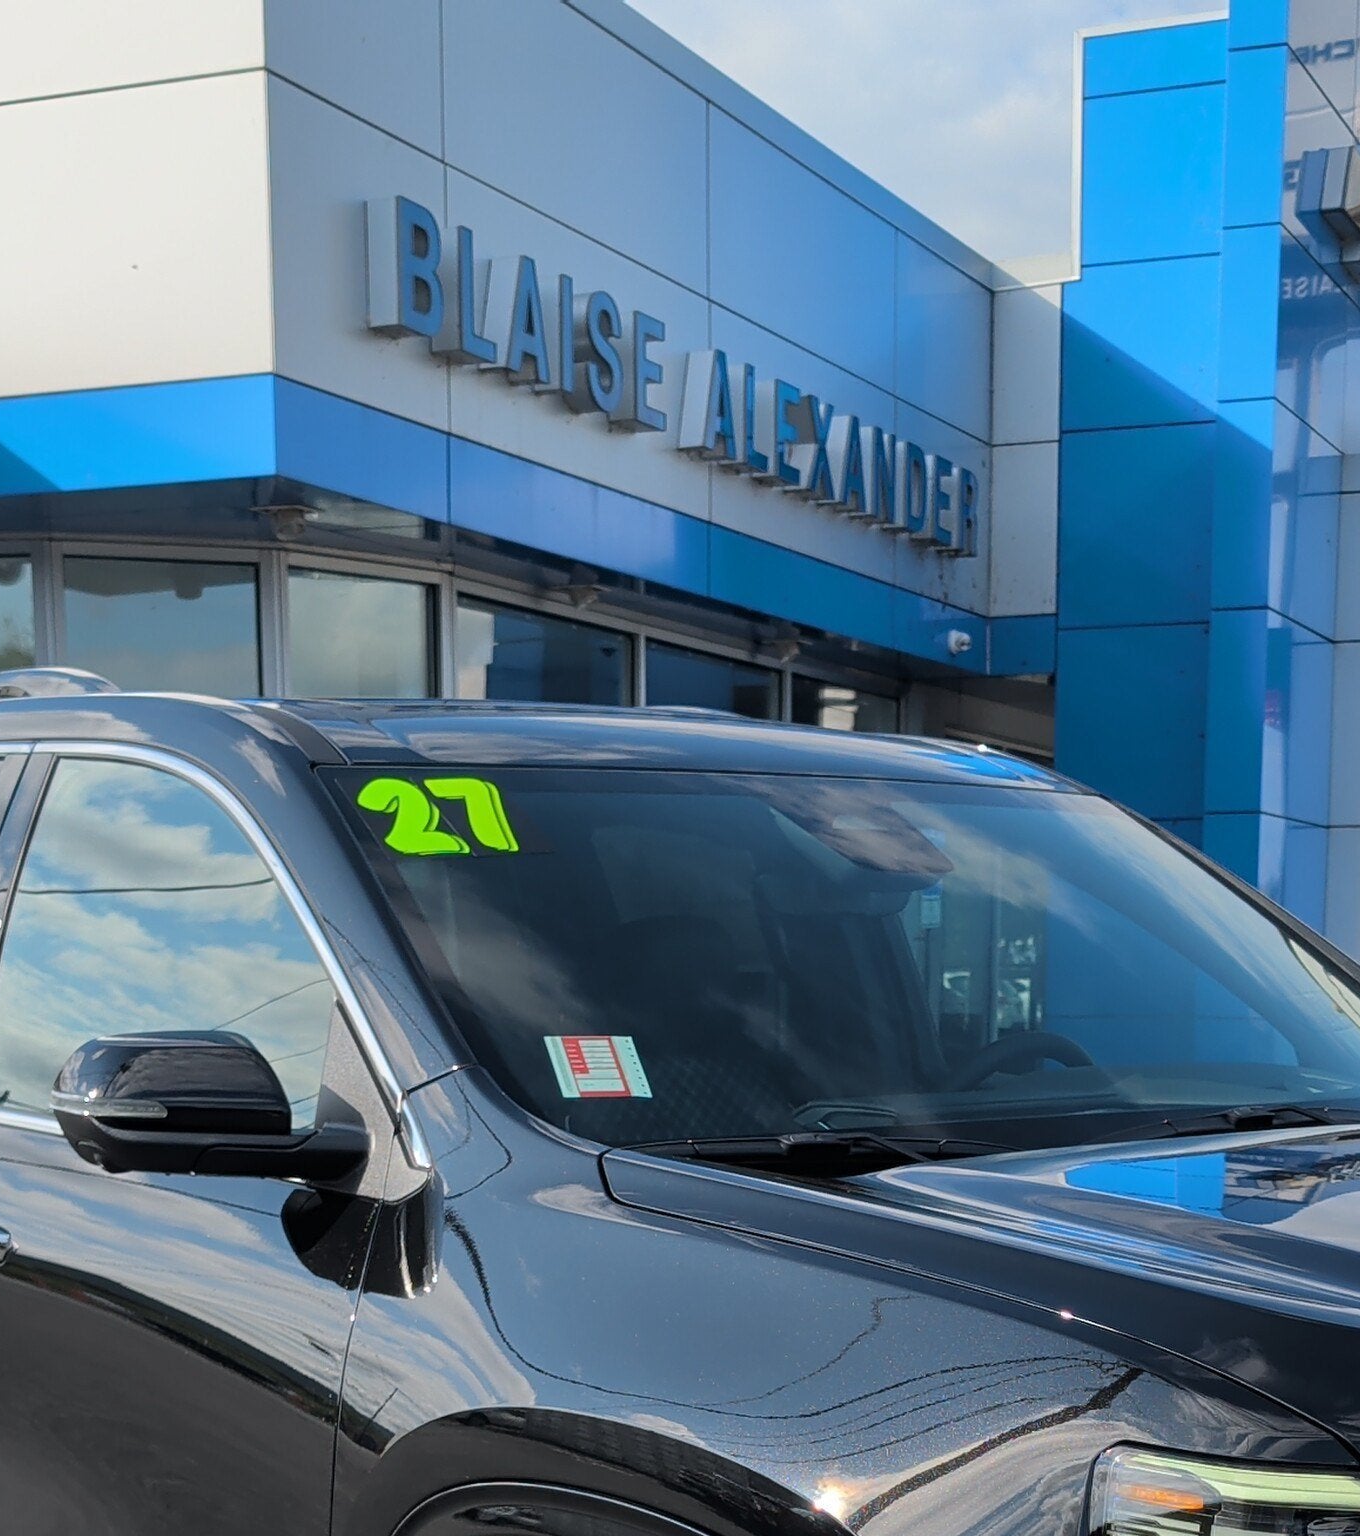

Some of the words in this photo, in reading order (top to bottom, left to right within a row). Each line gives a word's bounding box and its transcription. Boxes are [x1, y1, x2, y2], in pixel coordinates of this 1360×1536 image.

[390, 195, 667, 433] BLAISE
[698, 348, 979, 557] ALEXANDER
[357, 777, 519, 856] 27
